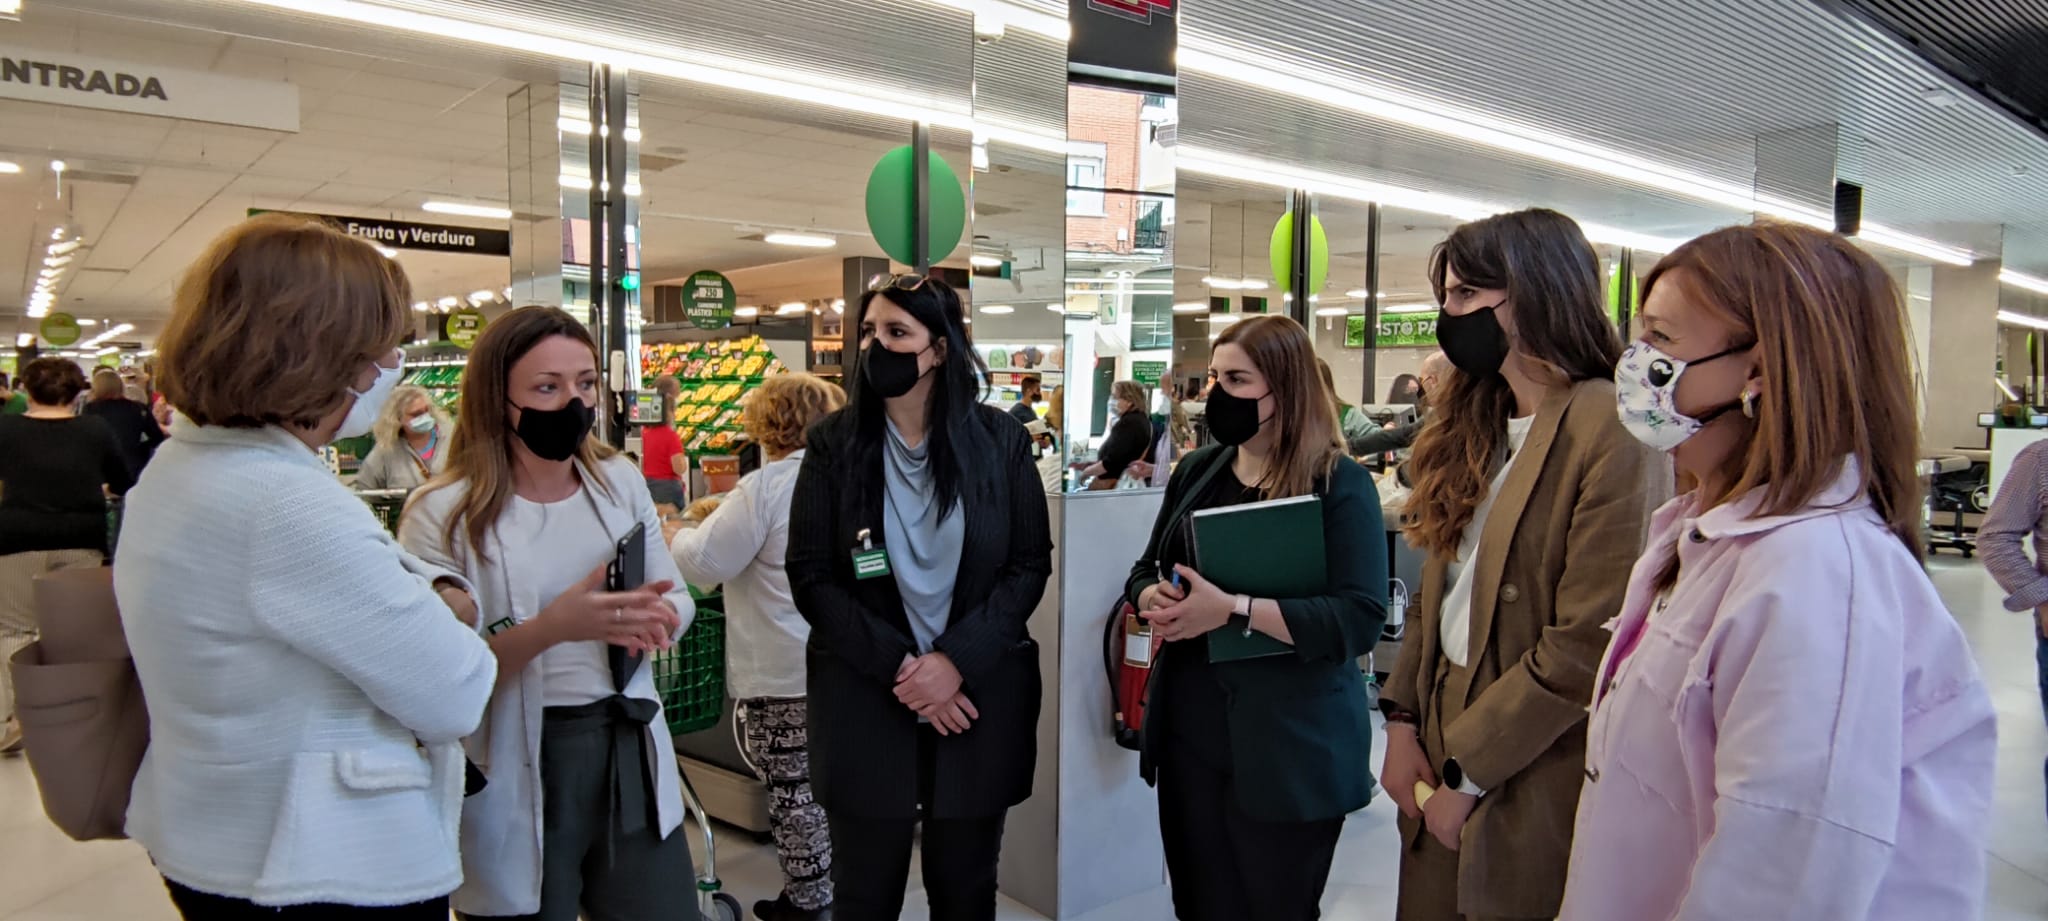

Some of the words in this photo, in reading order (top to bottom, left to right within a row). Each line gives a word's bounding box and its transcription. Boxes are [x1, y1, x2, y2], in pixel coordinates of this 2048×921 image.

[0, 57, 169, 101] NTRADA
[347, 222, 395, 240] Fruta
[398, 229, 408, 244] y
[411, 227, 476, 246] Verdura
[1377, 321, 1413, 336] ISTO
[1417, 320, 1437, 335] PA
